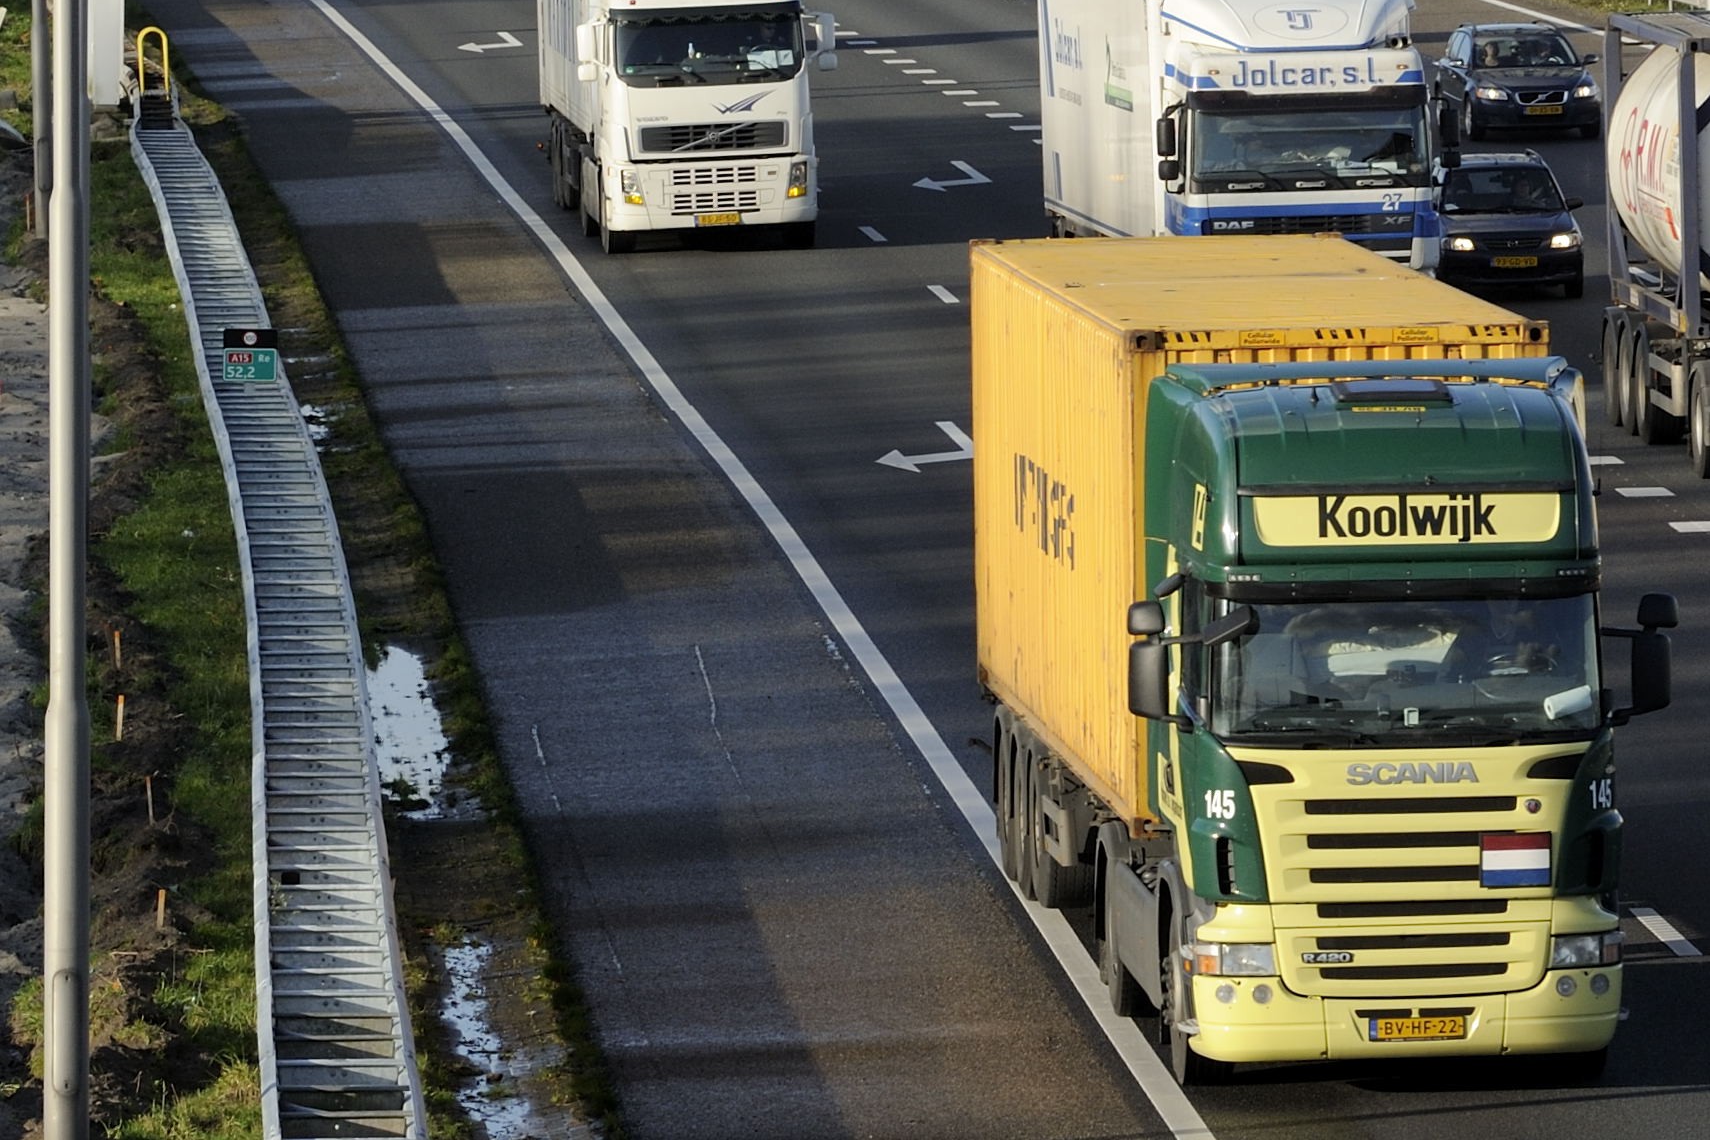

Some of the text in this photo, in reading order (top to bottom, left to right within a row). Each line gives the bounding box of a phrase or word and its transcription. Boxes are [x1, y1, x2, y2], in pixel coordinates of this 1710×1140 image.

[1232, 57, 1384, 88] Jolcar, s.l.
[1382, 193, 1402, 211] 27
[1213, 215, 1411, 230] DAF XF
[231, 354, 271, 363] A15 Re
[226, 366, 255, 379] 52,2
[1318, 493, 1498, 543] Koolwijk
[1346, 761, 1479, 785] SCANIA
[1204, 789, 1236, 820] 145
[1588, 780, 1613, 810] 145
